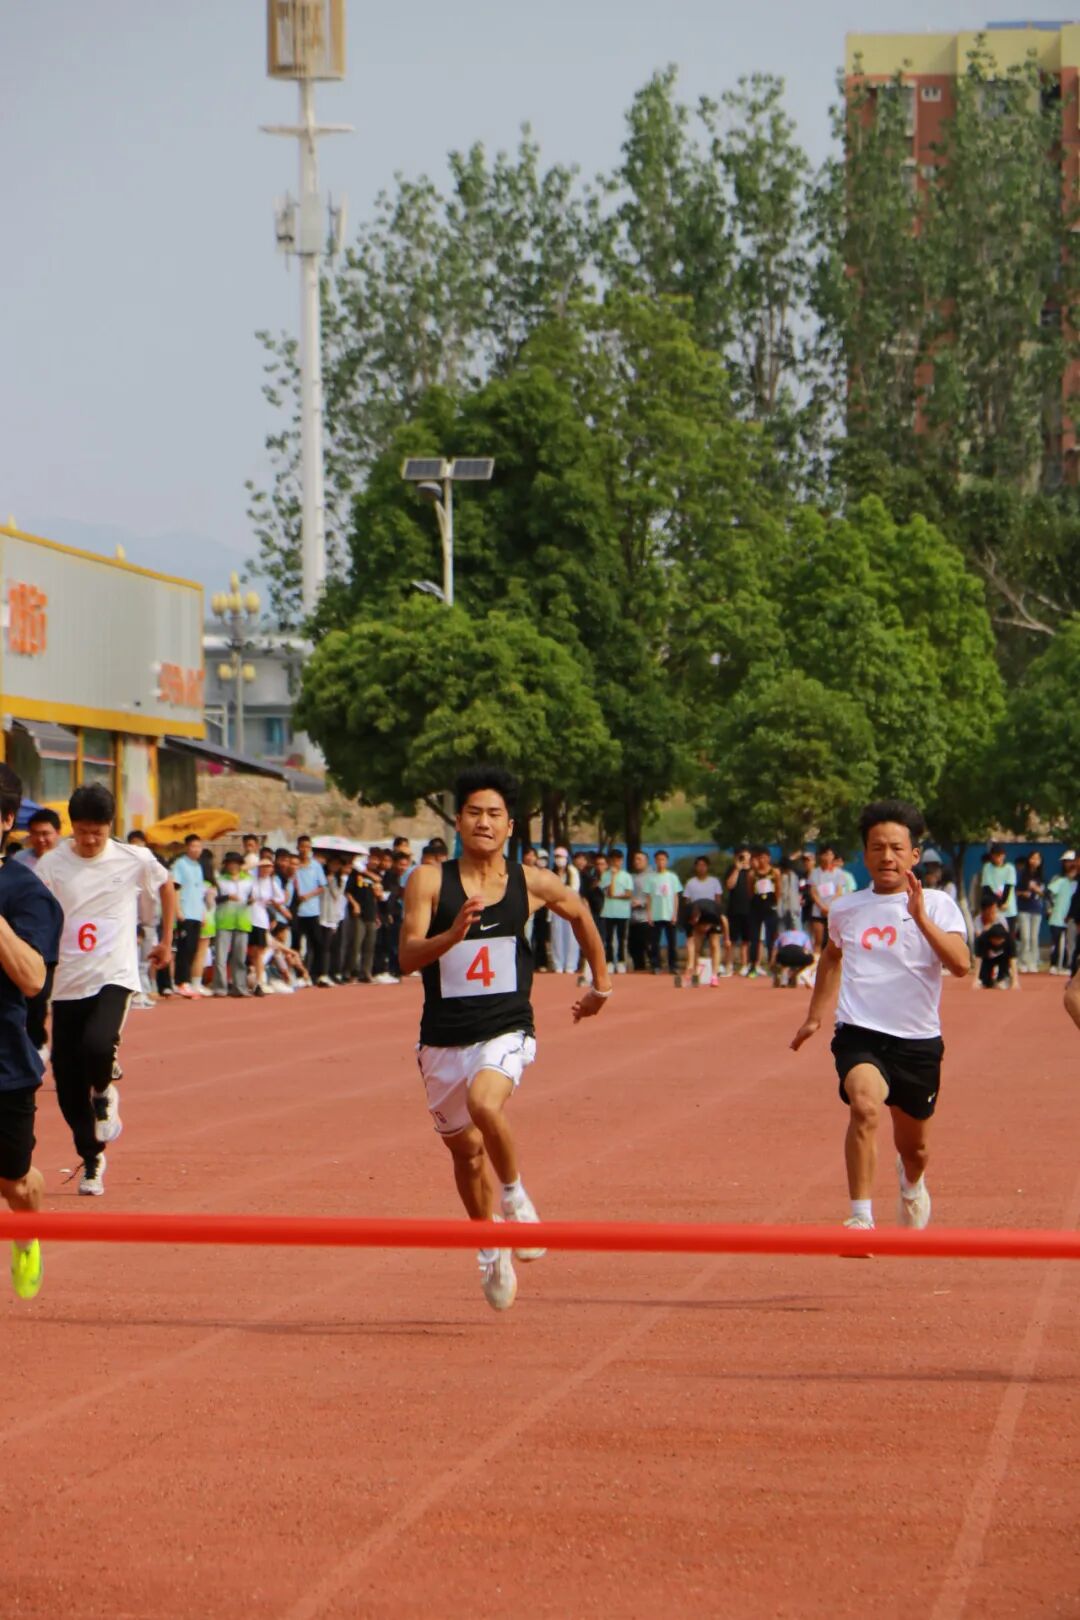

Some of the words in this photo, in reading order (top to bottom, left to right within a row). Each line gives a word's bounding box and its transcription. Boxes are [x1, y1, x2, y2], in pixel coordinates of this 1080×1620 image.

[78, 922, 97, 953] 6
[861, 926, 897, 951] 3
[466, 945, 496, 988] 4
